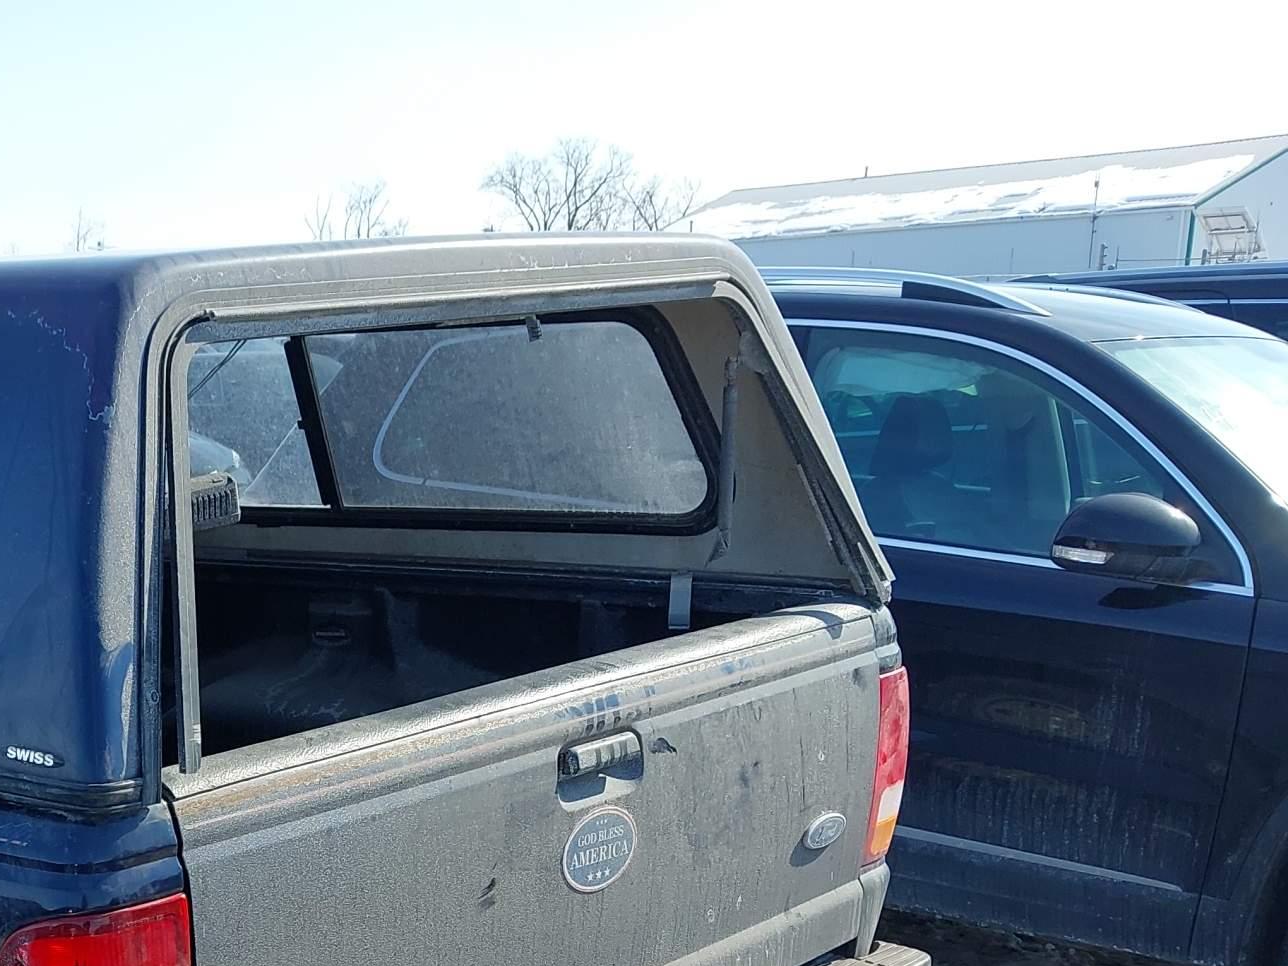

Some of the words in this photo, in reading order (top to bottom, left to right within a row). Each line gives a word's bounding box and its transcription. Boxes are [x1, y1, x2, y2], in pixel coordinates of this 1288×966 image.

[6, 745, 54, 767] SWISS
[577, 832, 597, 848] GOD
[598, 824, 624, 842] BLESS
[569, 839, 629, 870] AMERICA
